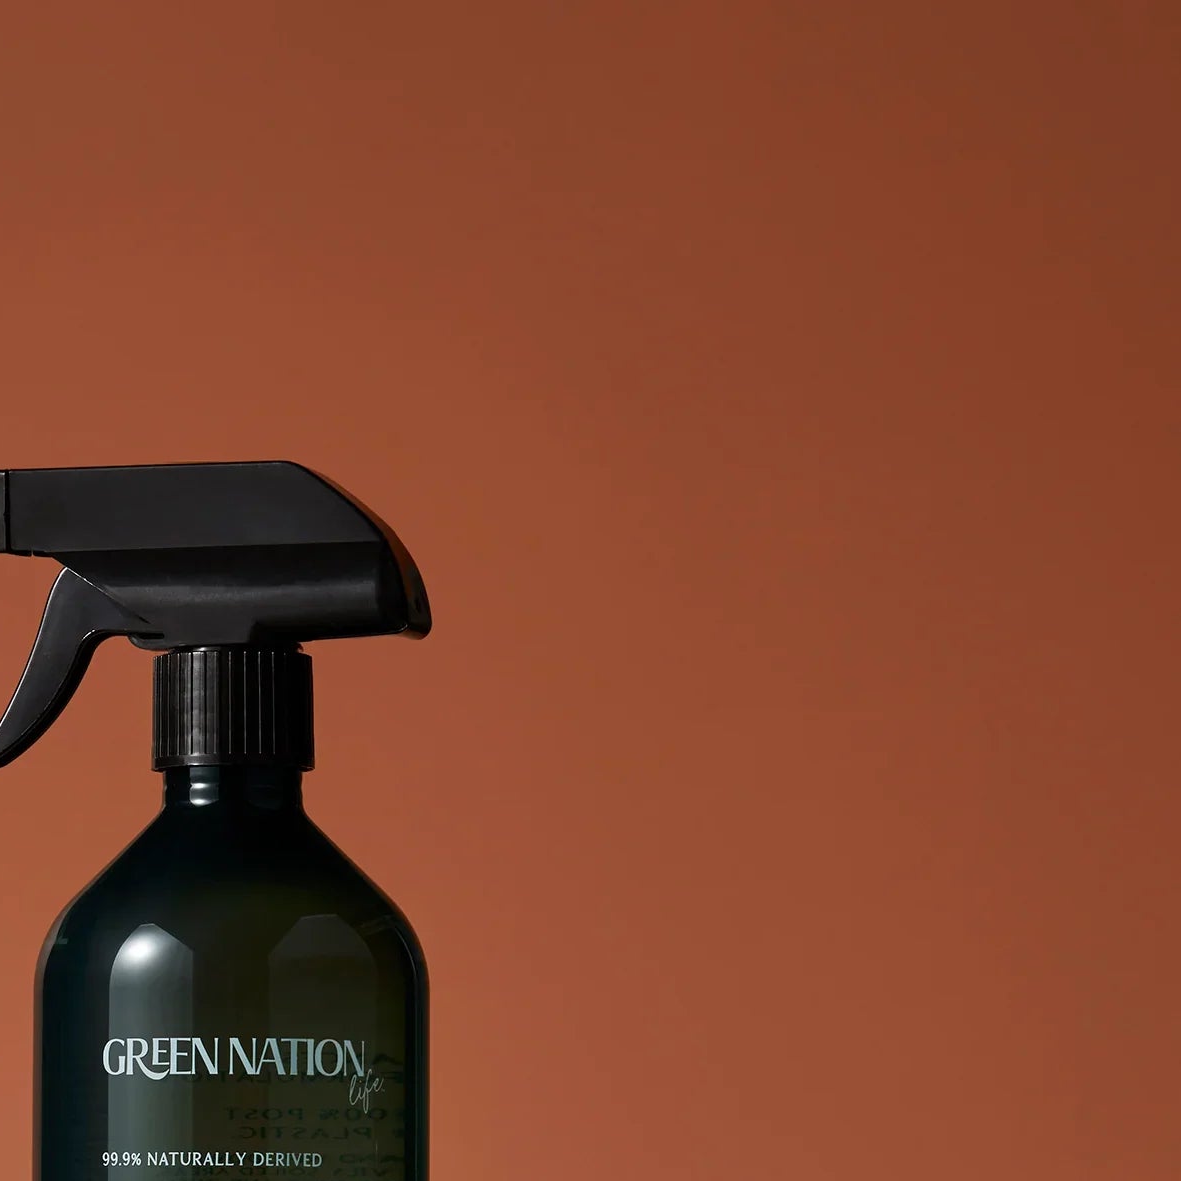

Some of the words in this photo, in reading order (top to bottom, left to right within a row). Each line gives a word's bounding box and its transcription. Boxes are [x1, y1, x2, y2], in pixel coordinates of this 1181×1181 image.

[103, 1038, 218, 1080] GREEN
[229, 1038, 364, 1077] NATION
[102, 1153, 141, 1167] 99.9%
[147, 1153, 246, 1166] NATURALLY
[254, 1153, 322, 1167] DERIVED
